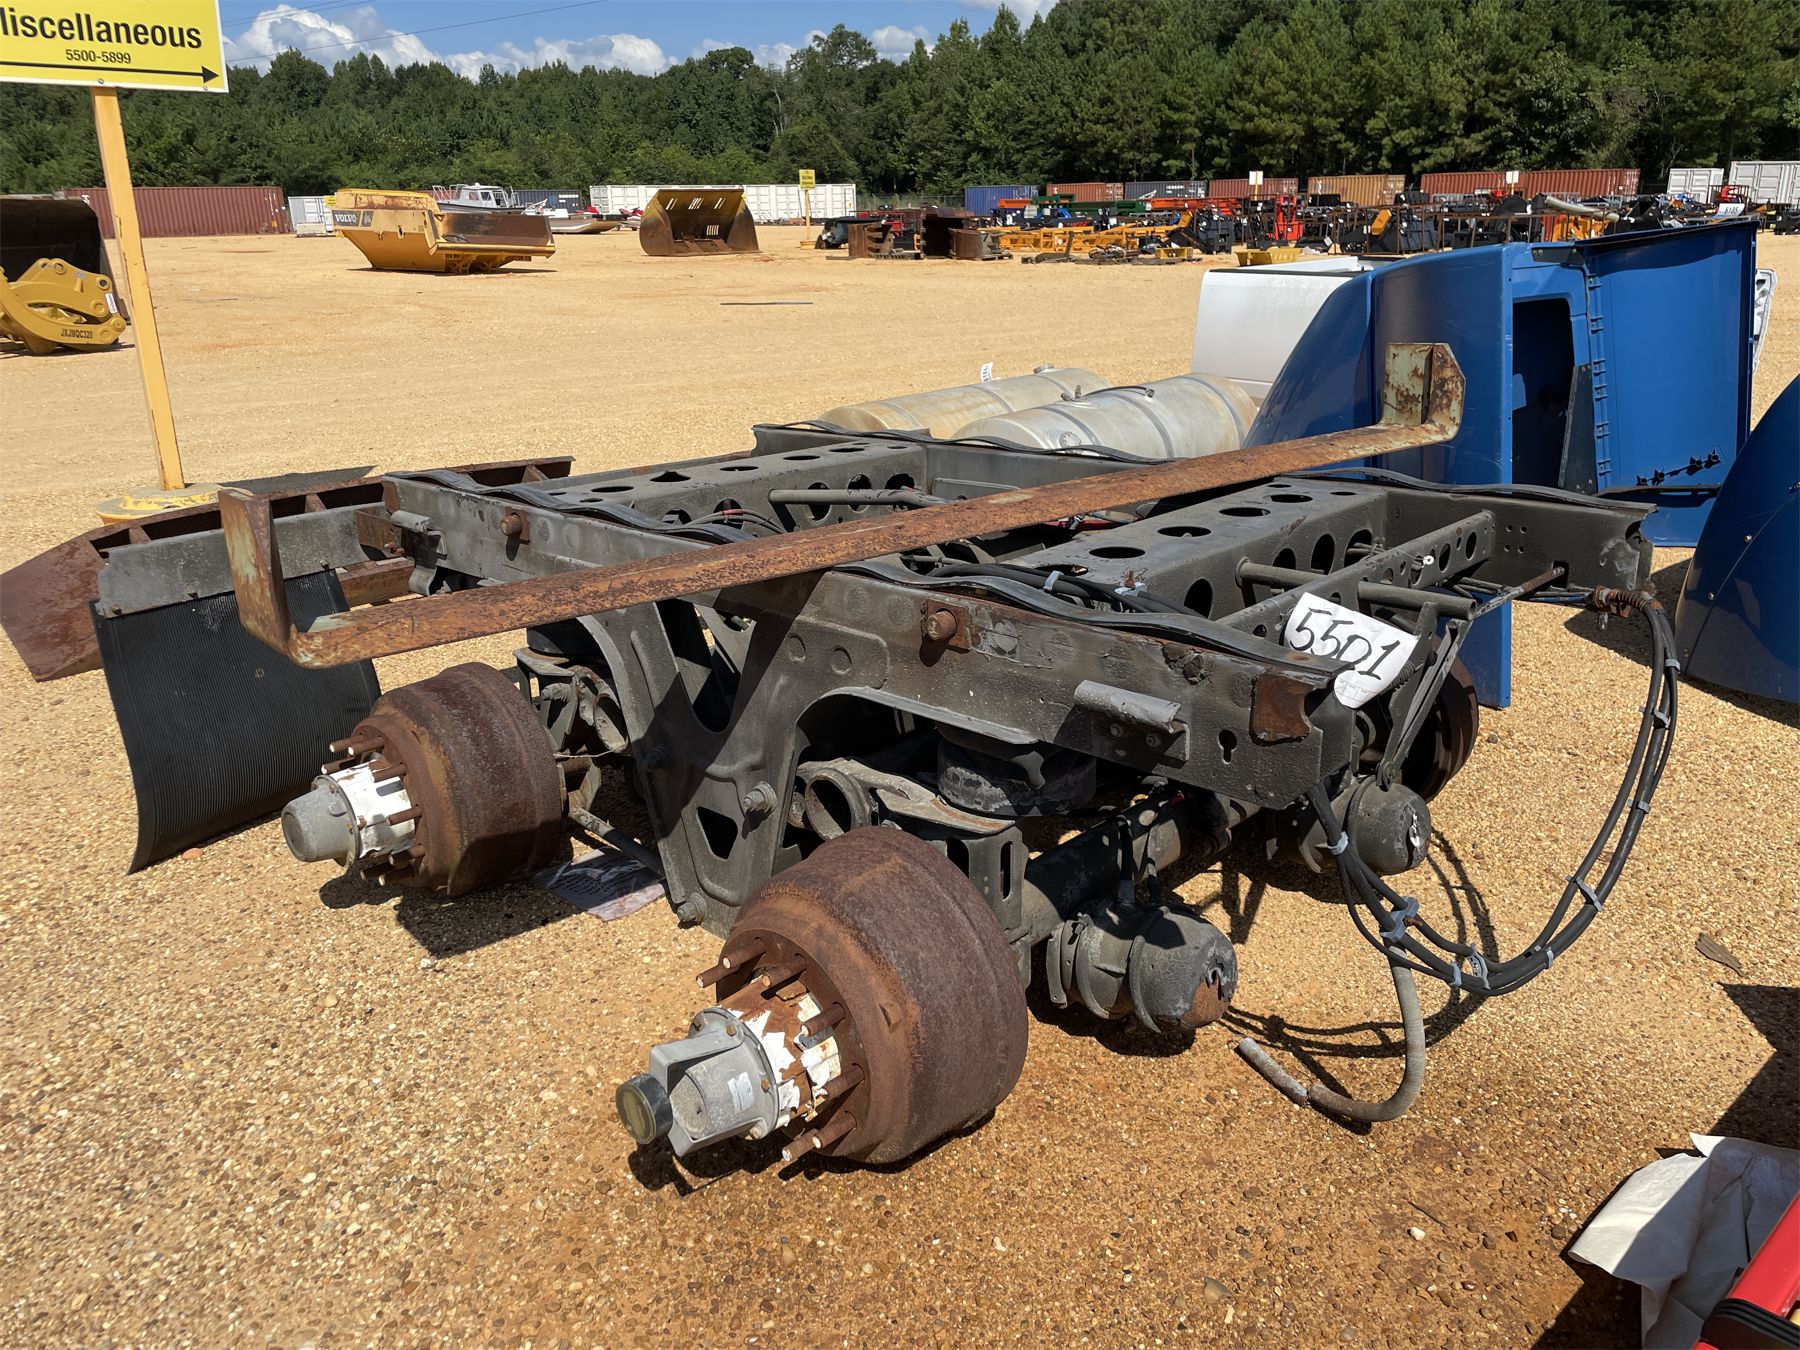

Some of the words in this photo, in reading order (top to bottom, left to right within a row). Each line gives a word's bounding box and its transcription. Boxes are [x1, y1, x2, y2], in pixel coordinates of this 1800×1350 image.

[65, 48, 131, 64] 5500-5899
[334, 213, 357, 223] VOLVO
[1289, 607, 1401, 681] 5501
